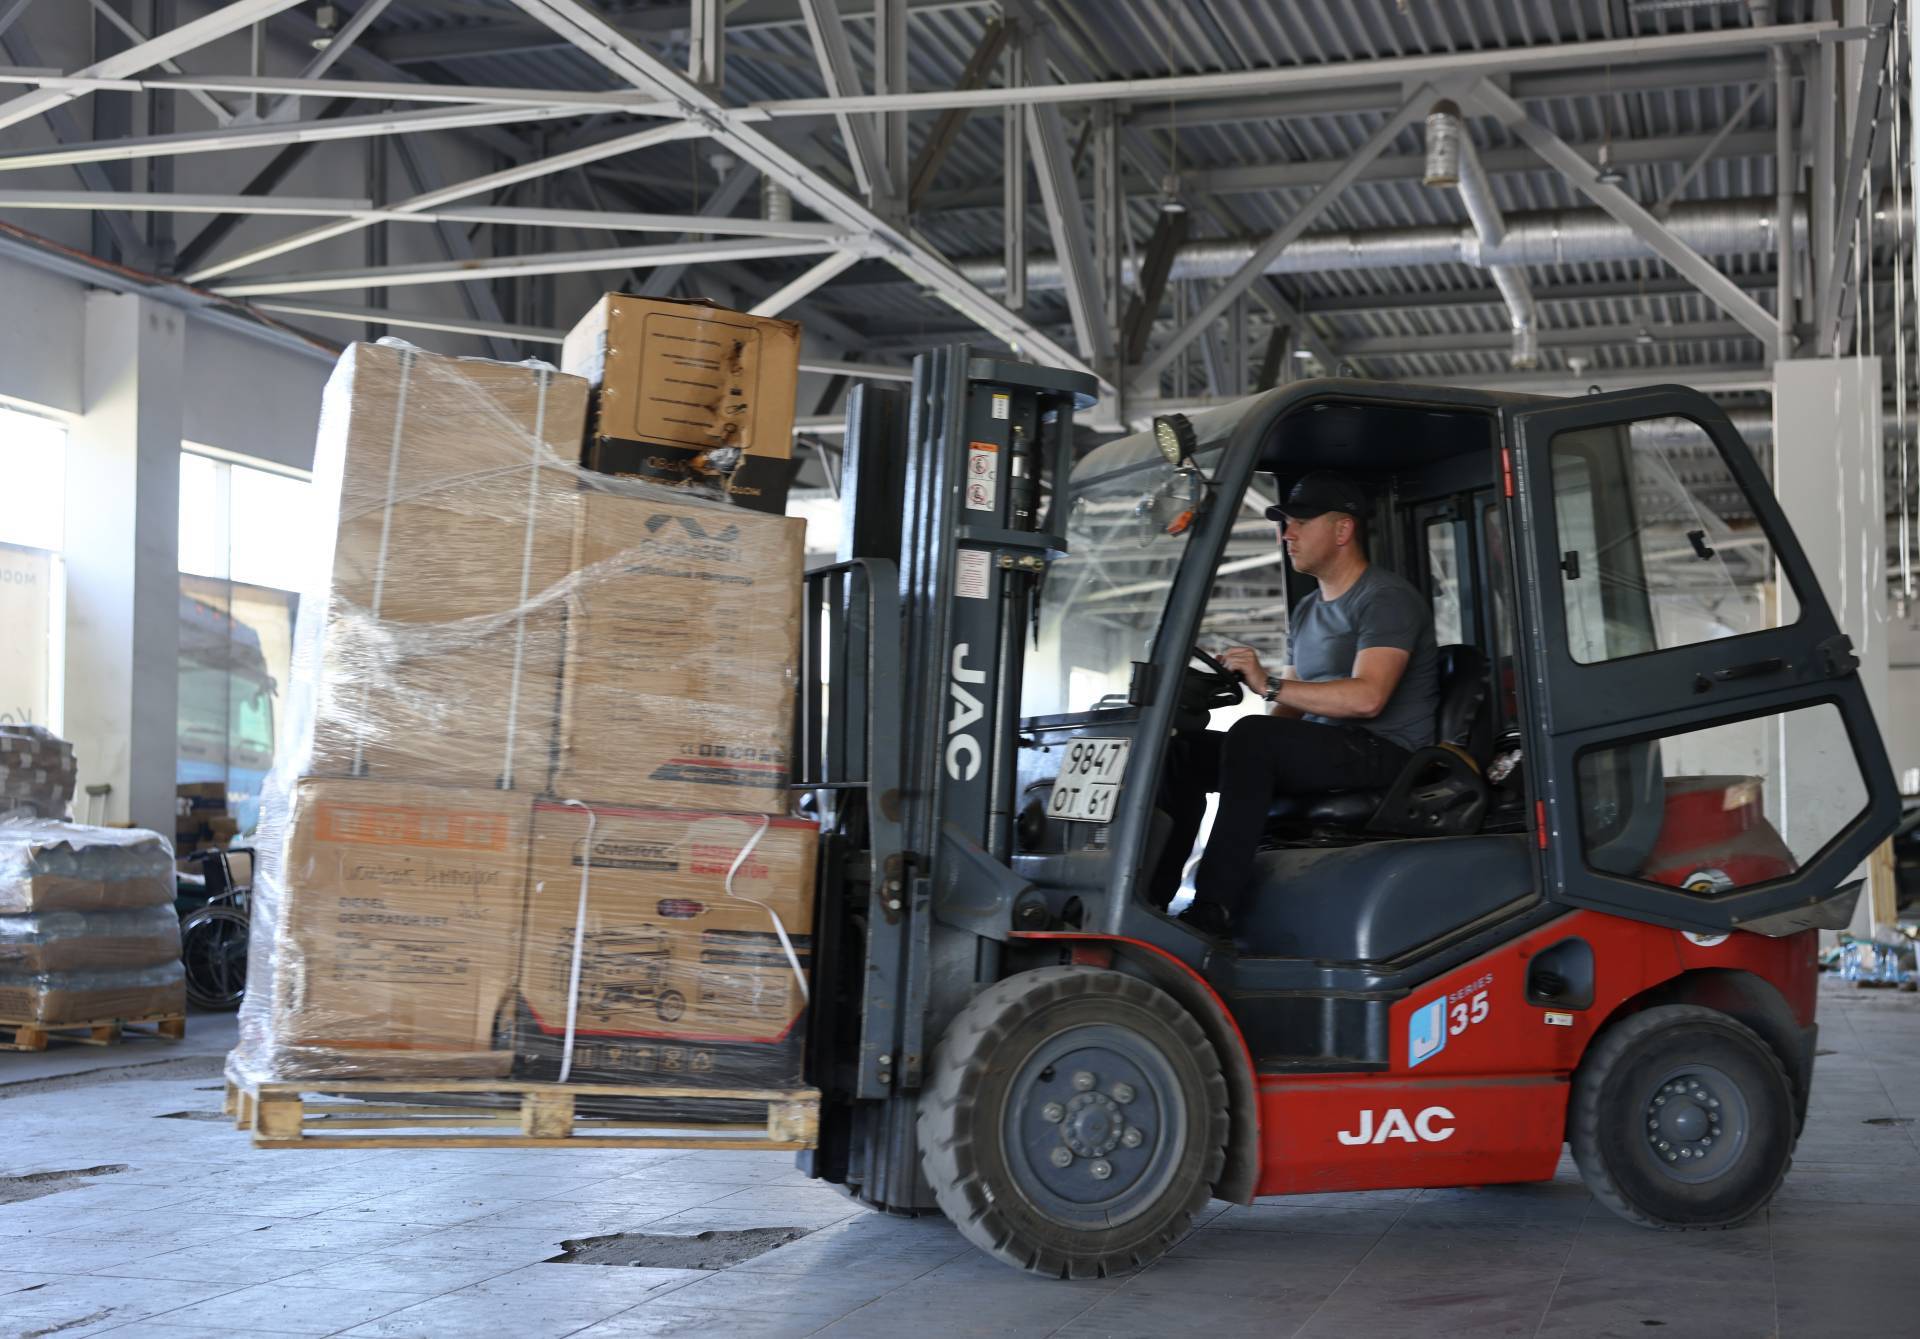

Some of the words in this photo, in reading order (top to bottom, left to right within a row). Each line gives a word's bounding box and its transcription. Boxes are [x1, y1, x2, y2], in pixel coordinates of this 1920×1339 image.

[945, 642, 985, 781] JAC
[1068, 743, 1121, 776] 9847
[1088, 789, 1112, 815] 61
[1448, 973, 1494, 1004] SERIES
[1449, 990, 1489, 1036] 35
[1338, 1106, 1456, 1145] JAC
